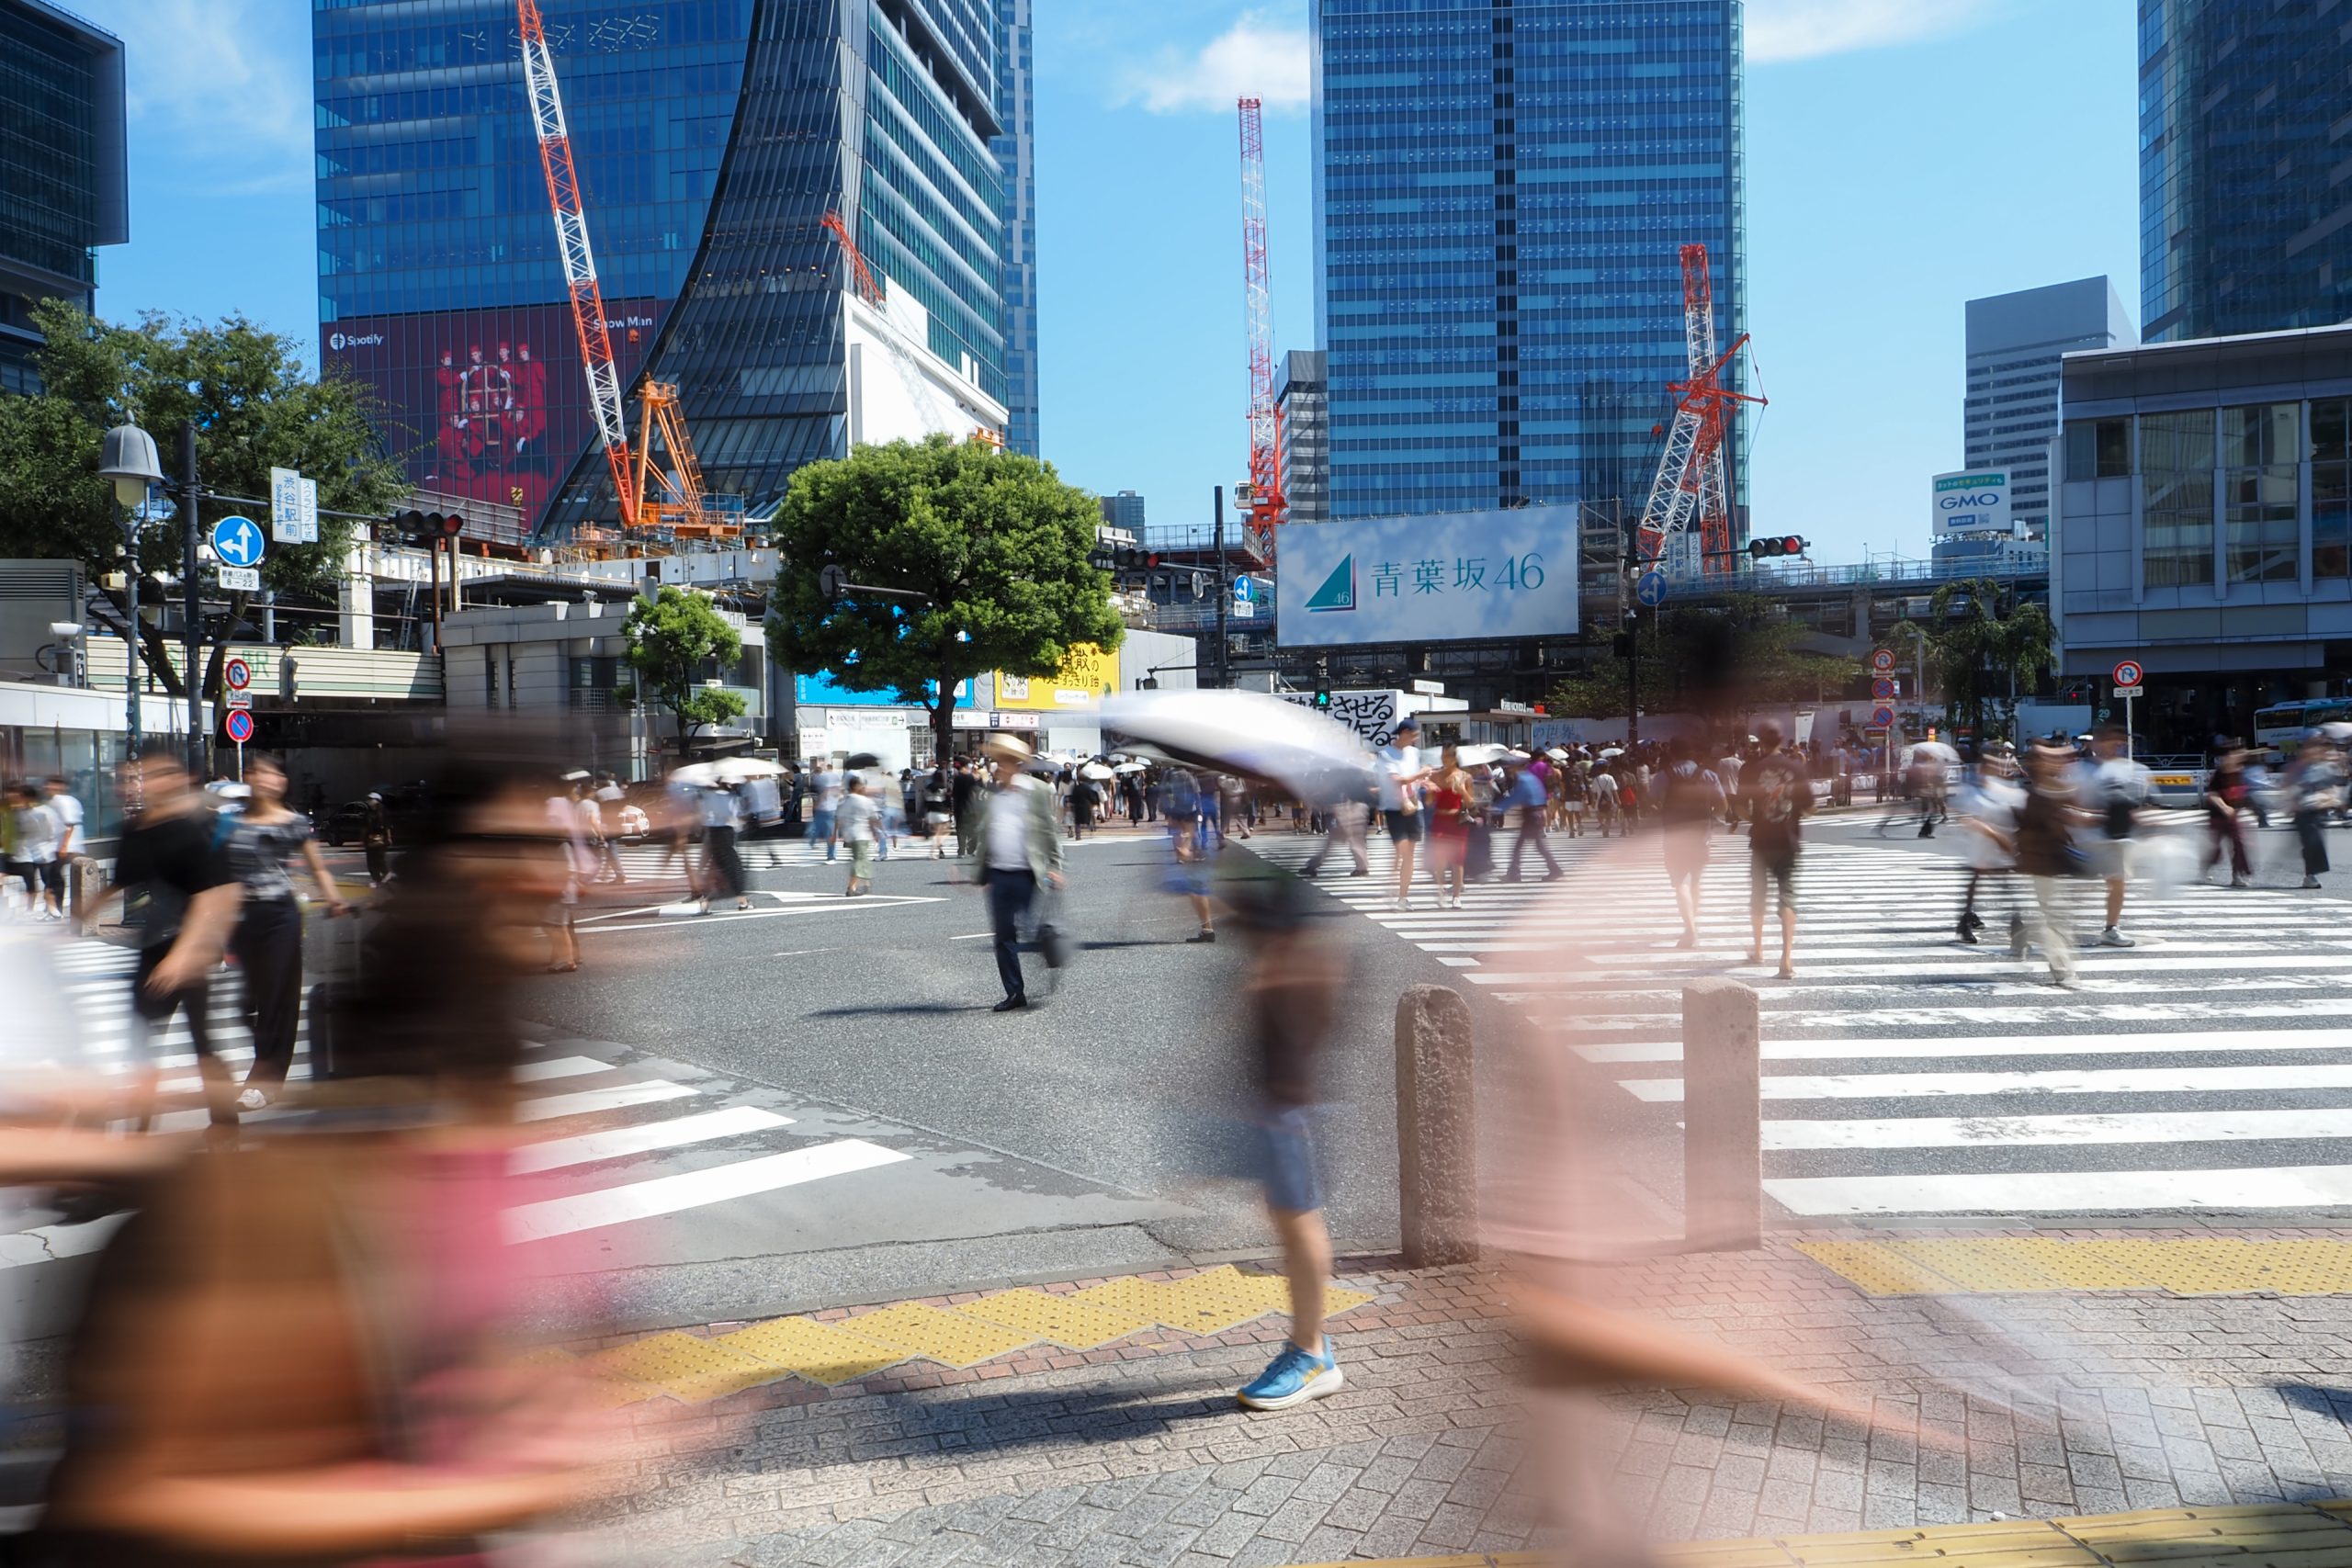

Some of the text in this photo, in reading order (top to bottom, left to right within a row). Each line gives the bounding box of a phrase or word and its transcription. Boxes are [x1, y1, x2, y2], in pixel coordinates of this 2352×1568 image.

[628, 315, 652, 327] Man
[347, 333, 384, 348] Spotify
[283, 476, 298, 537] 渋谷駅前
[1939, 493, 1999, 510] GMO
[1675, 536, 1685, 581] 渋谷駅前
[1333, 591, 1351, 604] 46
